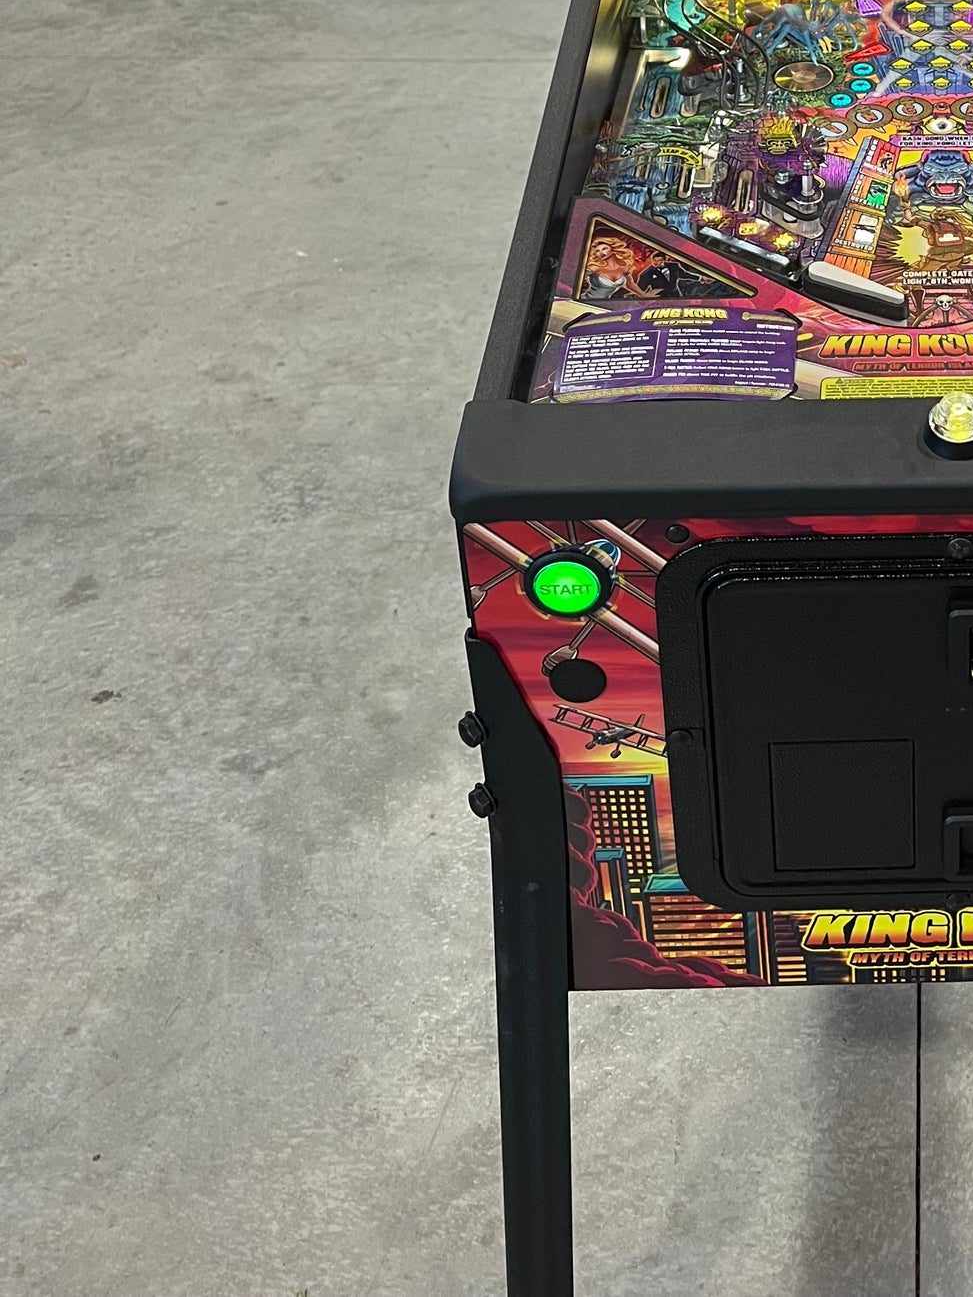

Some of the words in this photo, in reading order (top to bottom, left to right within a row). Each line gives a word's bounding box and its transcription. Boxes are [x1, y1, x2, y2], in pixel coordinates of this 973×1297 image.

[903, 270, 949, 278] COMPLETE
[951, 270, 972, 278] GATE
[640, 309, 682, 320] KING
[683, 308, 728, 320] KONG
[819, 333, 912, 358] KING
[855, 362, 887, 371] MYTH
[889, 362, 902, 371] OF
[906, 362, 944, 371] TERROR
[540, 584, 593, 595] START
[802, 910, 952, 949] KING
[852, 952, 904, 964] MYTH
[909, 952, 931, 963] OF
